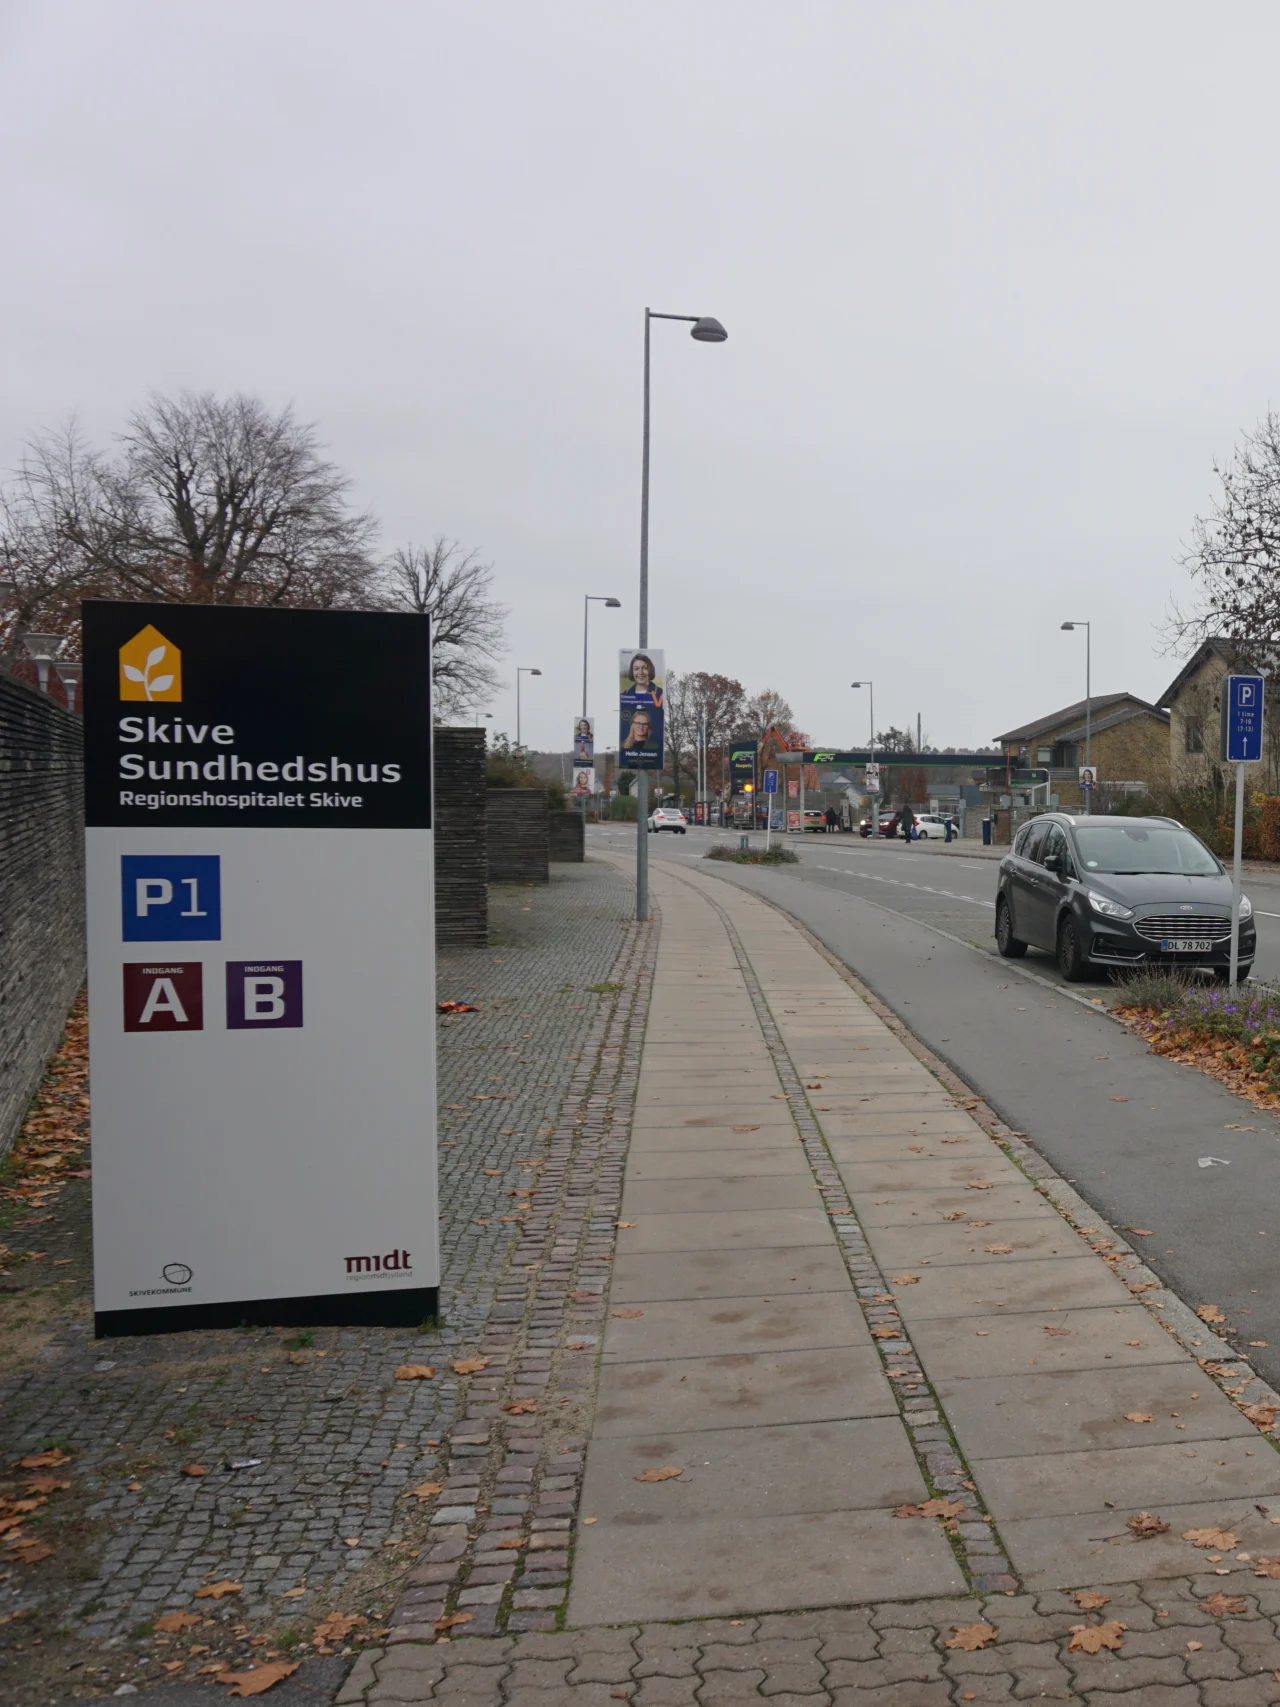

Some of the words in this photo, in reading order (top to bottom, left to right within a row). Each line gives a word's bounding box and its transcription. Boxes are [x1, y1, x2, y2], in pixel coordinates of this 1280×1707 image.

[1242, 686, 1252, 704] P
[118, 716, 235, 745] Skive
[118, 754, 402, 783] Sundhedshus
[119, 790, 305, 810] Regionshospitalet
[309, 792, 363, 808] Skive
[136, 878, 208, 917] P1
[1168, 941, 1180, 950] DL
[1182, 941, 1193, 950] 78
[1195, 941, 1211, 950] 702
[142, 967, 184, 975] INDGANG
[244, 965, 284, 973] INDGANG
[138, 977, 189, 1024] A
[243, 976, 285, 1021] B
[343, 1249, 413, 1273] midt
[129, 1286, 192, 1297] SKIVEKOMMUNE
